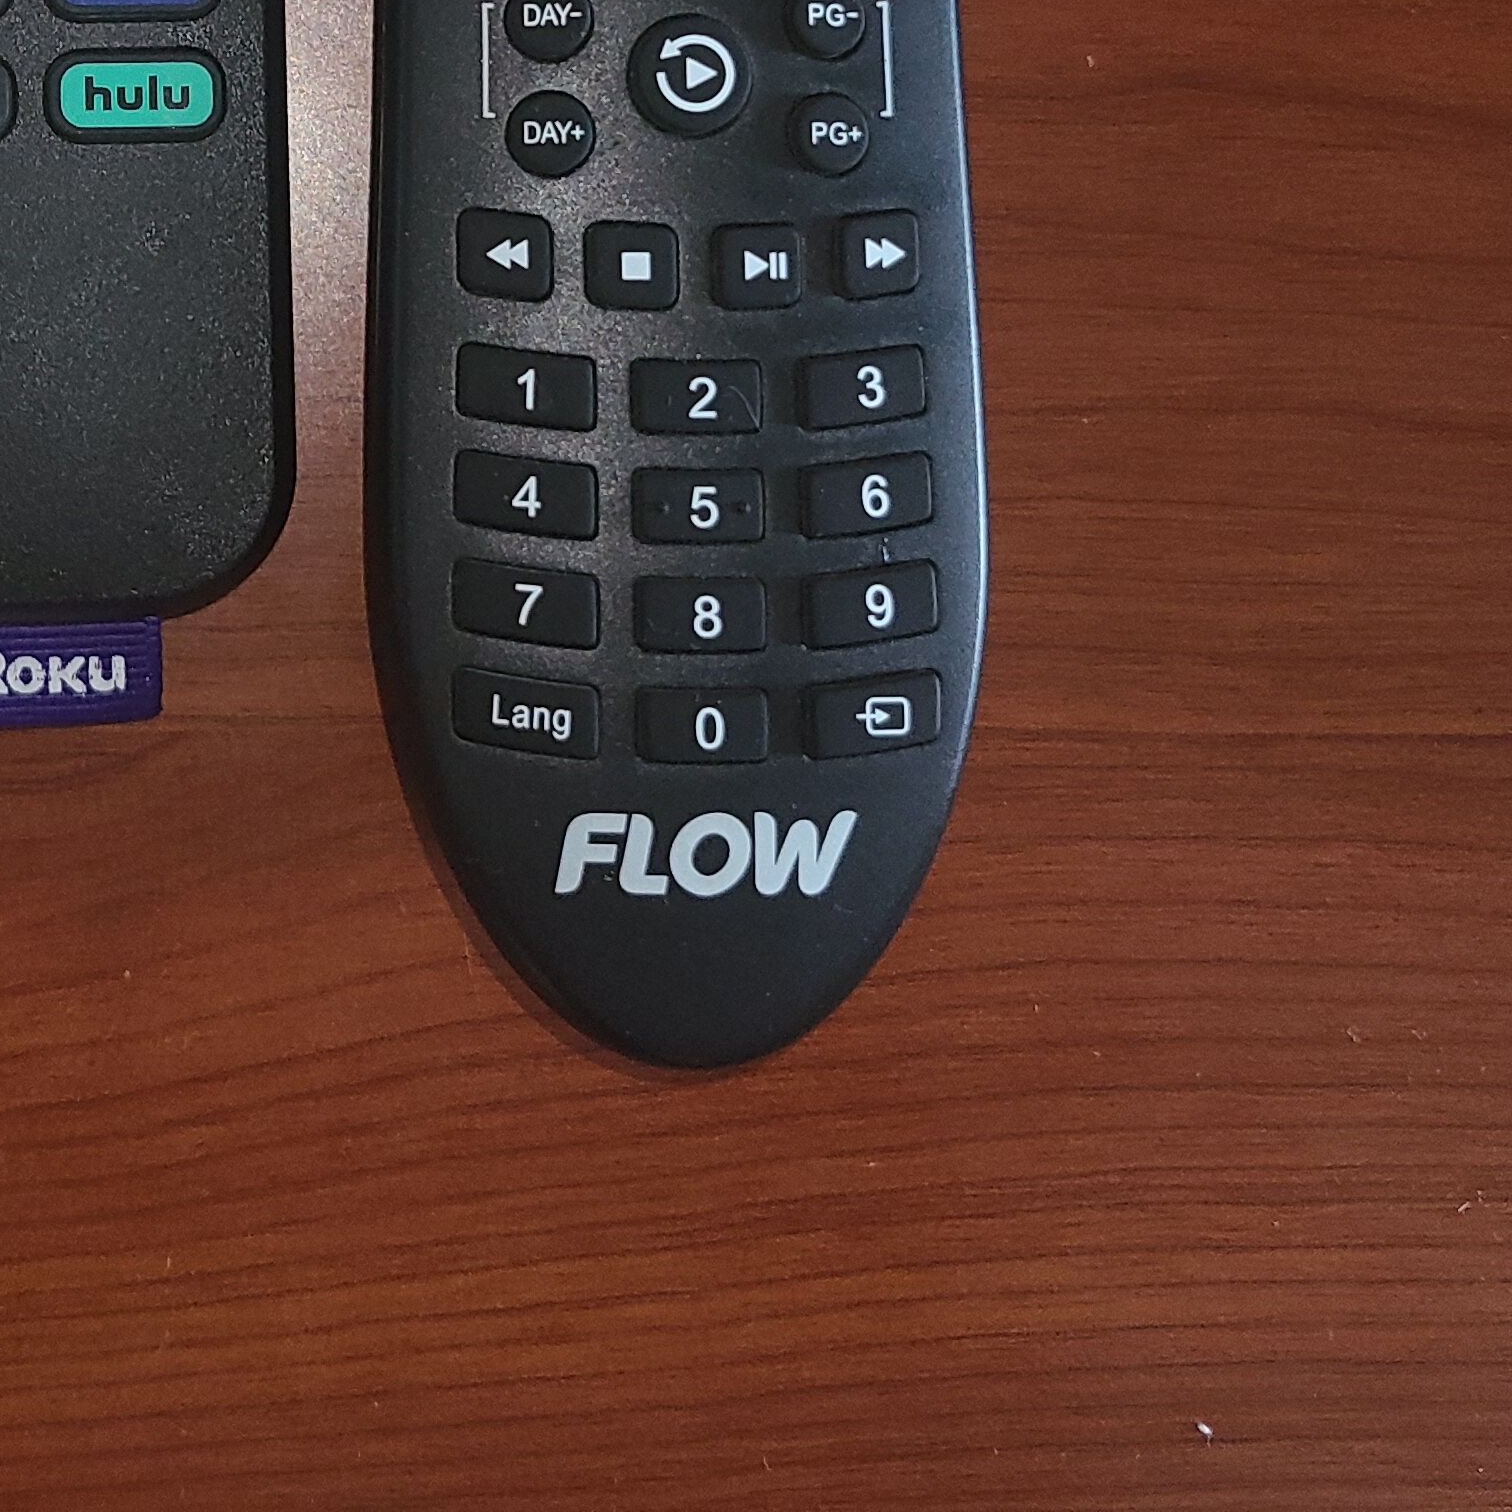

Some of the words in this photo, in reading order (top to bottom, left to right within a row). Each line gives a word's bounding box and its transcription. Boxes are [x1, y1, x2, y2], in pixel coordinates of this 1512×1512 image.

[84, 76, 190, 111] hulu
[523, 120, 585, 145] DAY+
[811, 121, 863, 146] PG+
[517, 368, 536, 411] 1
[688, 376, 718, 419] 2
[857, 365, 886, 409] 3
[511, 475, 542, 518] 4
[690, 486, 720, 529] 5
[861, 474, 891, 518] 6
[514, 583, 544, 626] 7
[693, 595, 723, 639] 8
[865, 583, 895, 628] 9
[491, 693, 572, 741] Lang
[695, 706, 726, 750] 0
[554, 809, 858, 898] FLOW
